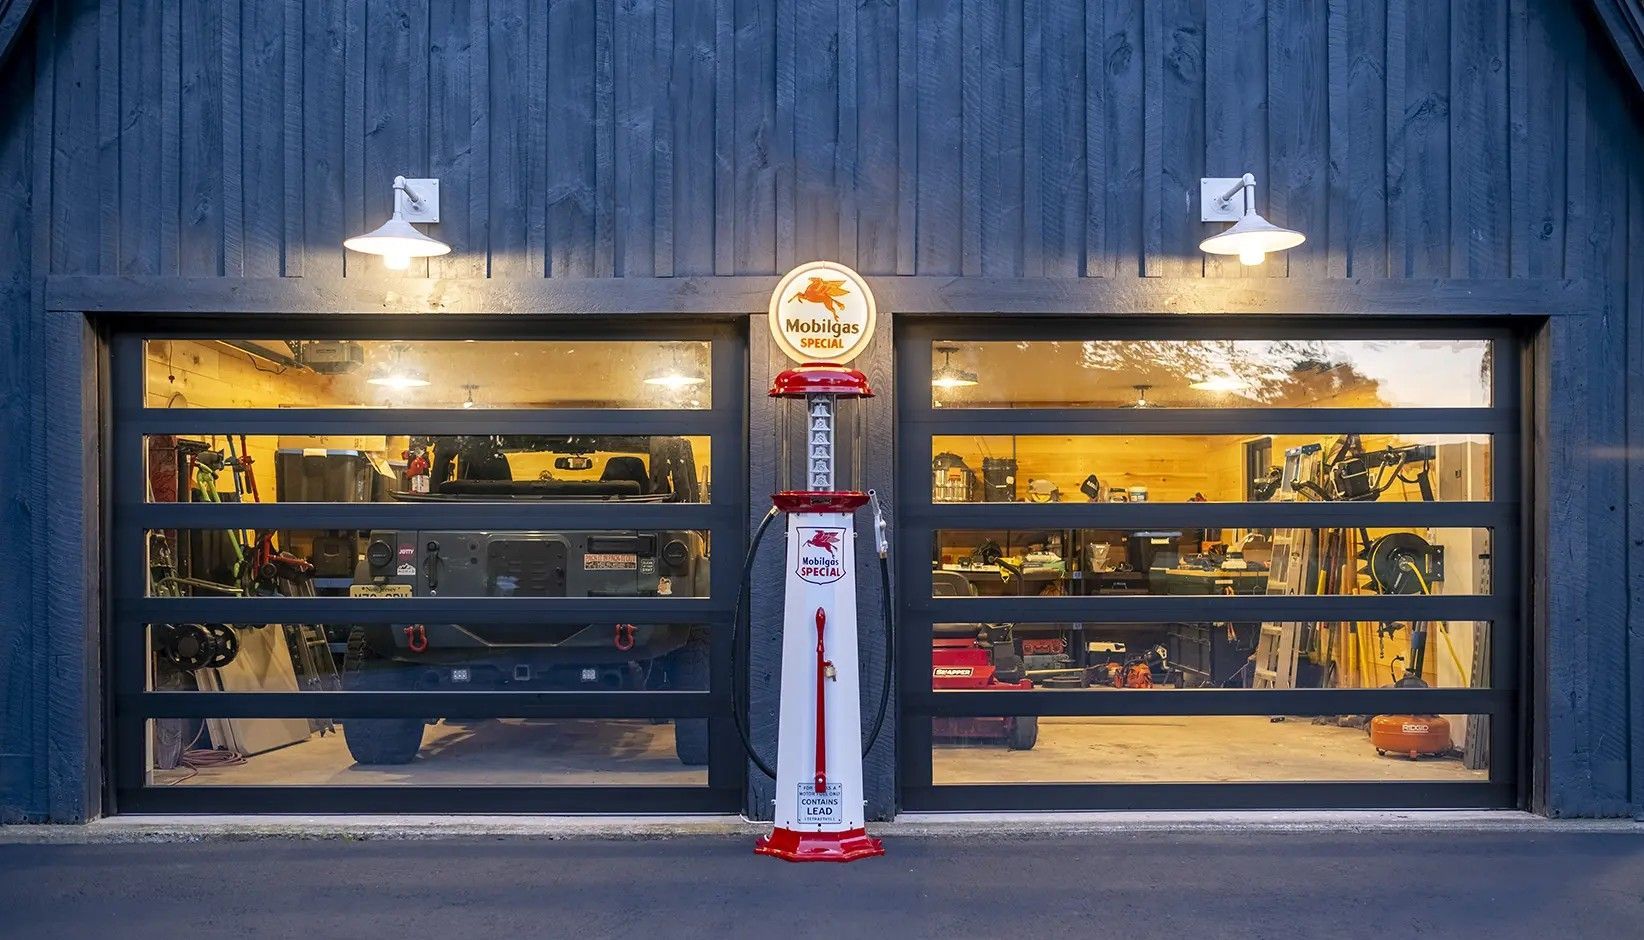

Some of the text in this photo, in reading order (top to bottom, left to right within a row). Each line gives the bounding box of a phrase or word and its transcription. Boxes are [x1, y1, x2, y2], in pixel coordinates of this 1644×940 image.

[786, 319, 859, 338] Mobilgas
[800, 338, 844, 348] SPECIAL
[802, 557, 839, 567] Mobilgas
[801, 567, 840, 576] SPECIAL
[807, 807, 833, 815] LEAD
